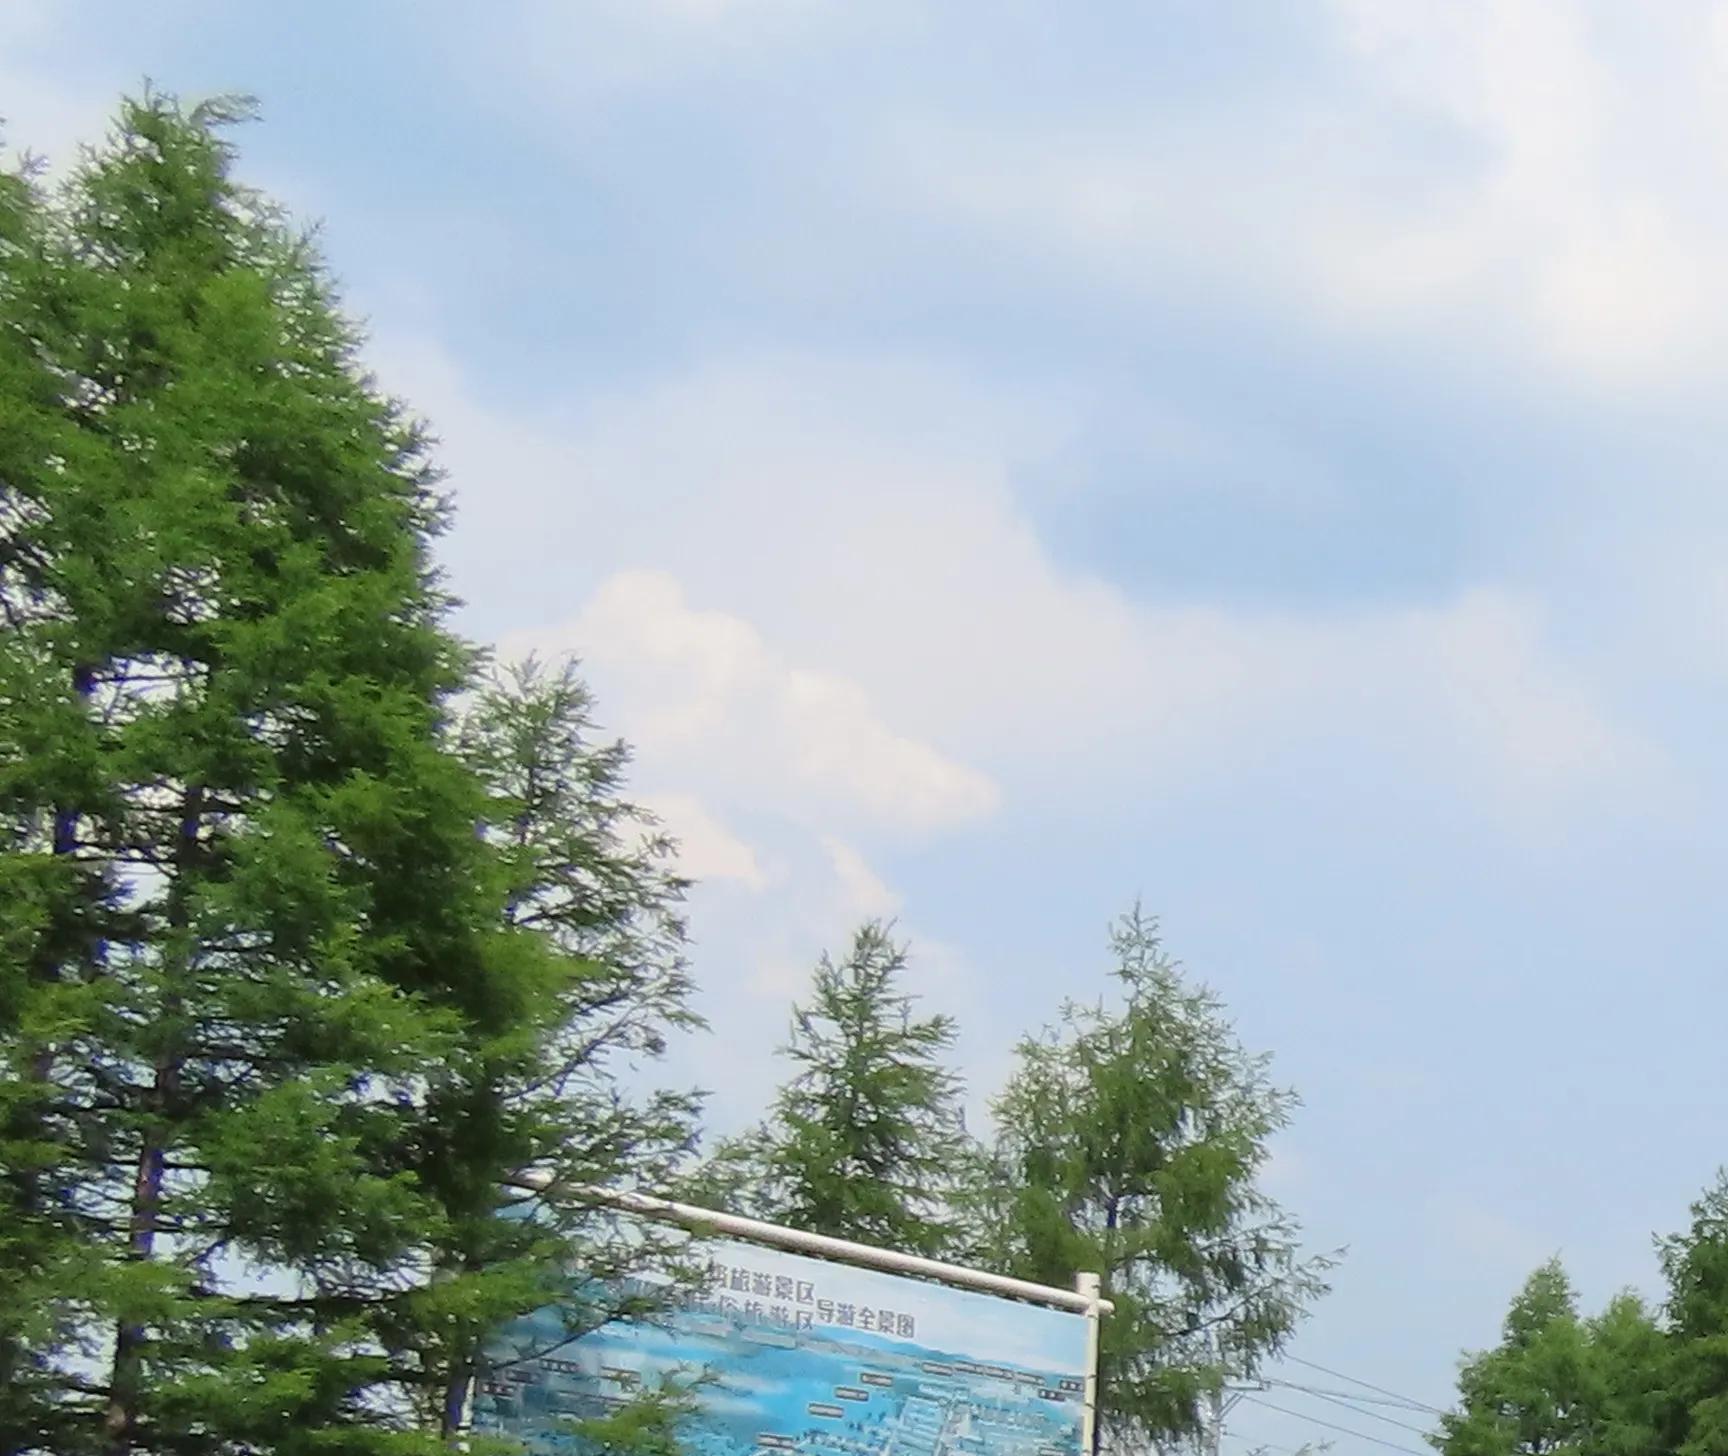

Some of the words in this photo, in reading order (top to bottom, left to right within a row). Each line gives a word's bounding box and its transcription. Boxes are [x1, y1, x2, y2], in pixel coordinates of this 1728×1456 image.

[816, 1299, 915, 1339] 导游全景图
